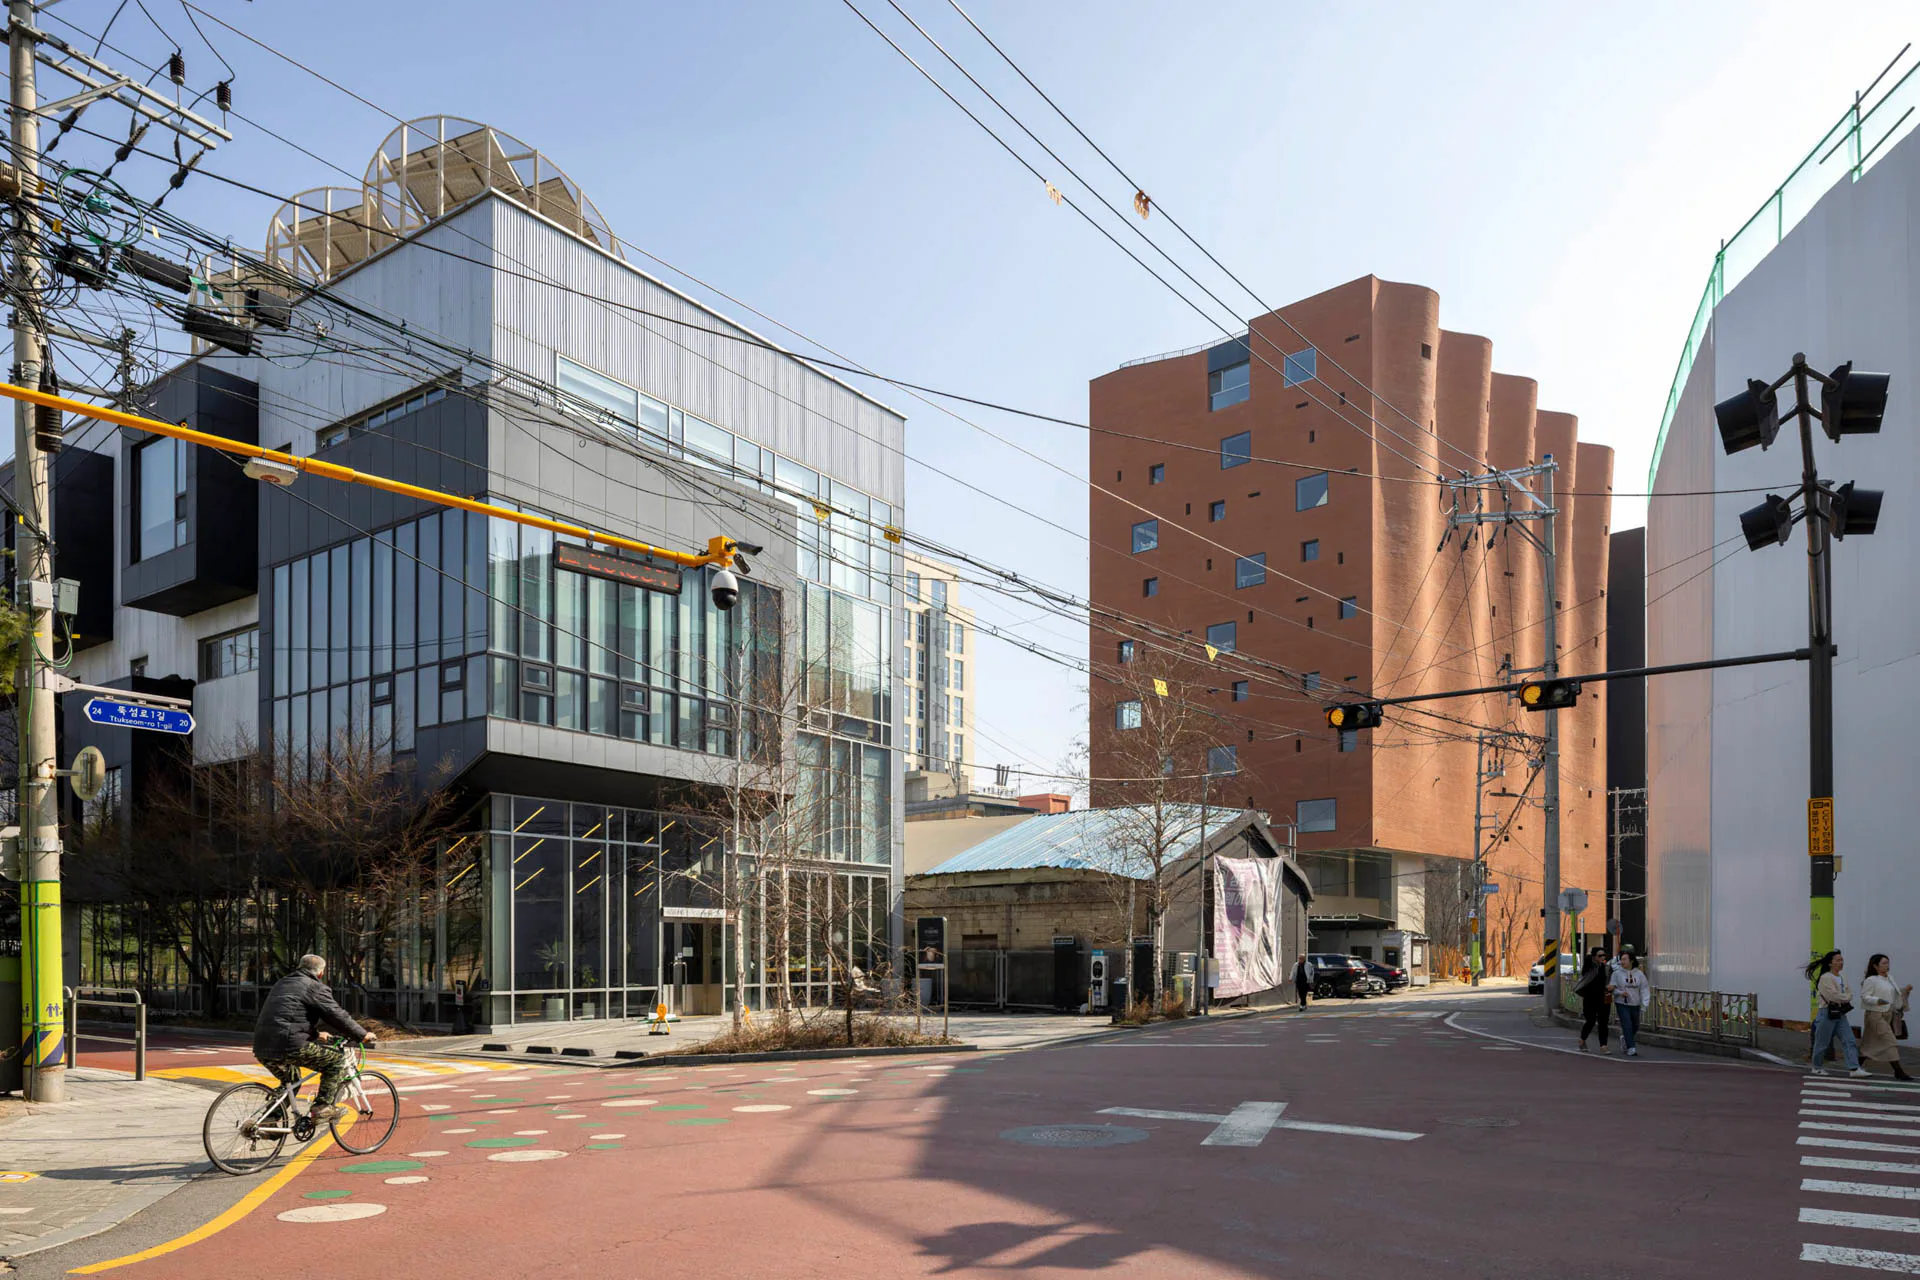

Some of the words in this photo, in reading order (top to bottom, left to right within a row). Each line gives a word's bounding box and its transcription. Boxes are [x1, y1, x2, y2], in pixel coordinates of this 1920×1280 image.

[92, 707, 102, 715] 24
[117, 706, 165, 721] 뚝섬로1길
[109, 715, 155, 727] Ttukseom-ro
[157, 722, 173, 730] 1-gil
[179, 719, 189, 727] 20
